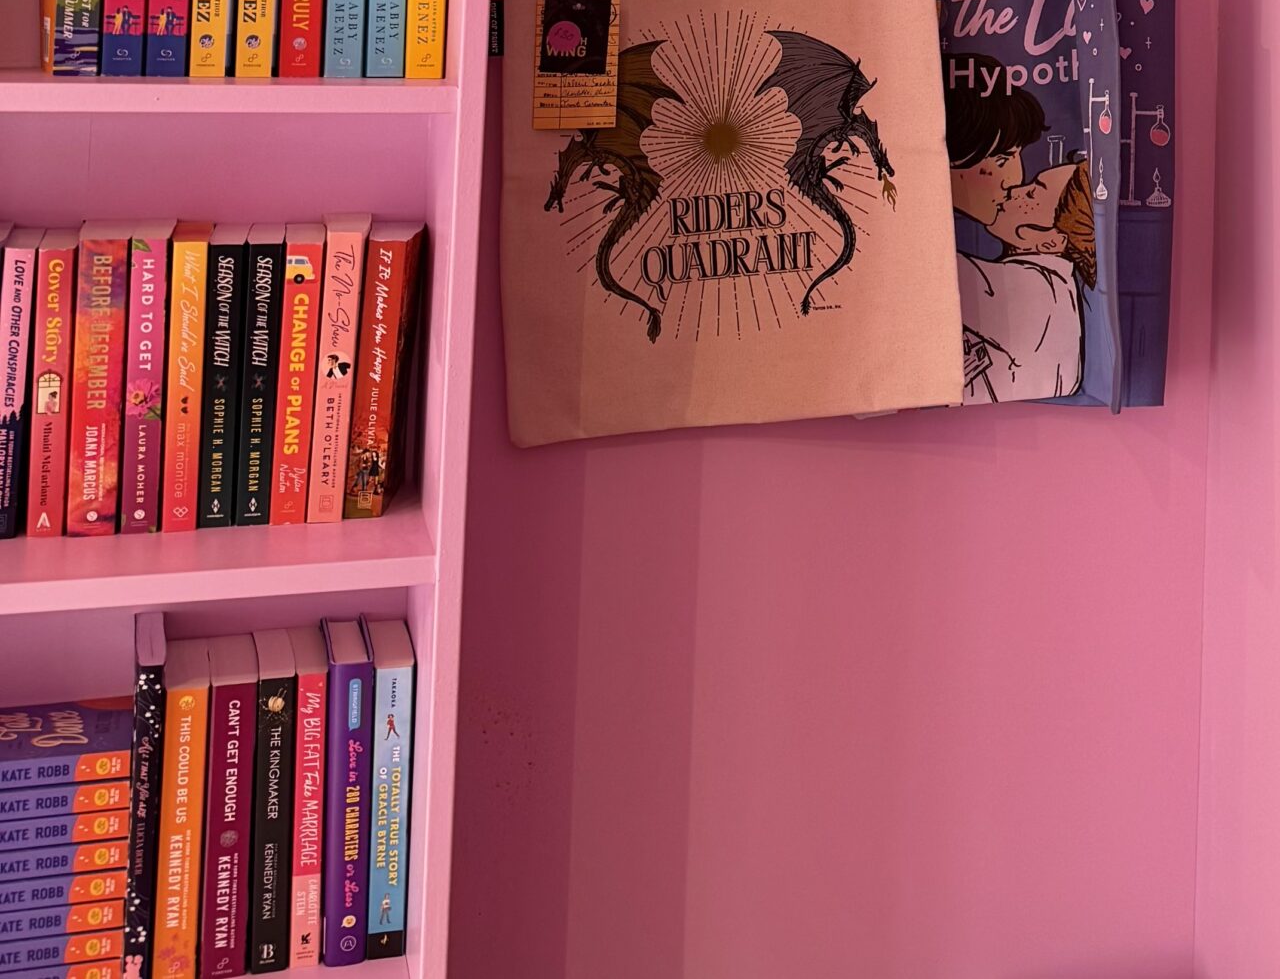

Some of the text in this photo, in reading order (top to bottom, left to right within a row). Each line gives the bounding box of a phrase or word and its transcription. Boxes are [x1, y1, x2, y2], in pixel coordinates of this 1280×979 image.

[82, 12, 90, 28] FOR
[492, 21, 497, 29] OF
[668, 188, 788, 239] RIDERS
[42, 259, 64, 363] Cover Story
[216, 255, 234, 303] SEASON
[218, 303, 230, 312] OF
[640, 231, 818, 303] QUADRANT
[139, 259, 155, 371] HARD TO GET
[213, 330, 232, 367] WITCH
[284, 293, 310, 455] CHANGE OF PLANS
[82, 425, 98, 501] JOANA MARCUS
[135, 424, 146, 503] LAURA MOHER
[210, 397, 225, 493] SOPHIE H. MORGAN
[322, 397, 335, 486] BETH O'LEARY
[2, 764, 70, 782] KATE ROBB
[176, 715, 192, 824] THIS COULD BE US
[224, 699, 241, 822] CAN'T GET ENOUGH
[267, 726, 281, 820] THE KINGMAKER
[376, 767, 388, 868] OF GRACIE BYRNE
[388, 745, 402, 886] THE TOTALLY TRUE STORY
[166, 835, 183, 928] KENNEDY RYAN
